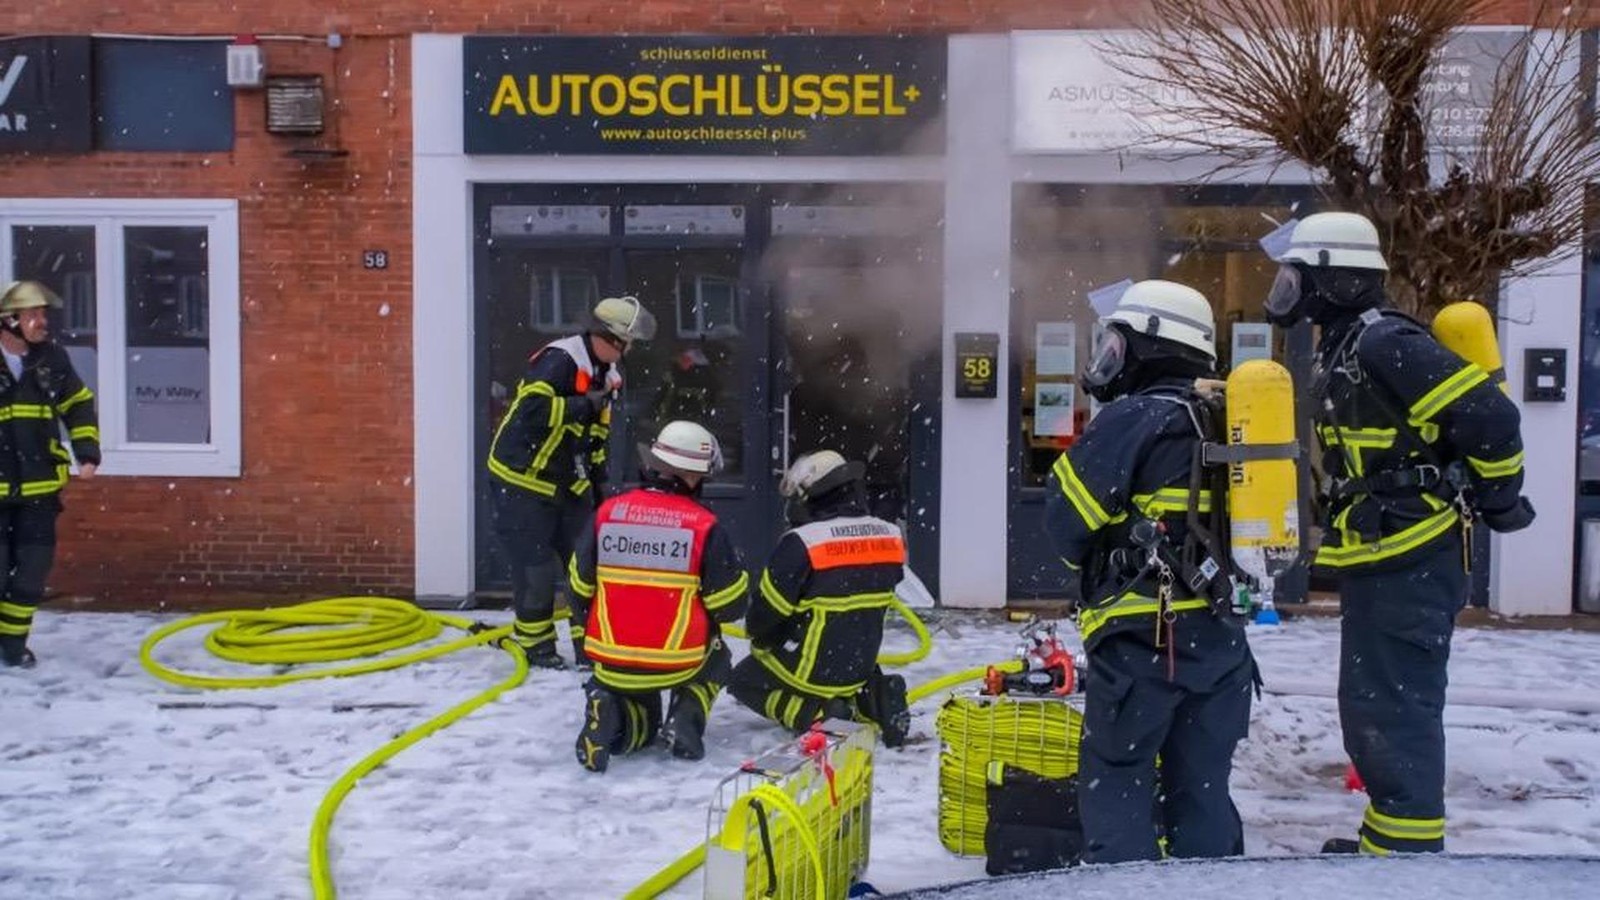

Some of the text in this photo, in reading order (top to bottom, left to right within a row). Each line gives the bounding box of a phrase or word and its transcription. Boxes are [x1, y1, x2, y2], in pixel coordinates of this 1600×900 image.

[365, 252, 386, 268] 58
[964, 358, 991, 378] 58
[602, 535, 689, 558] C-Dienst 21
